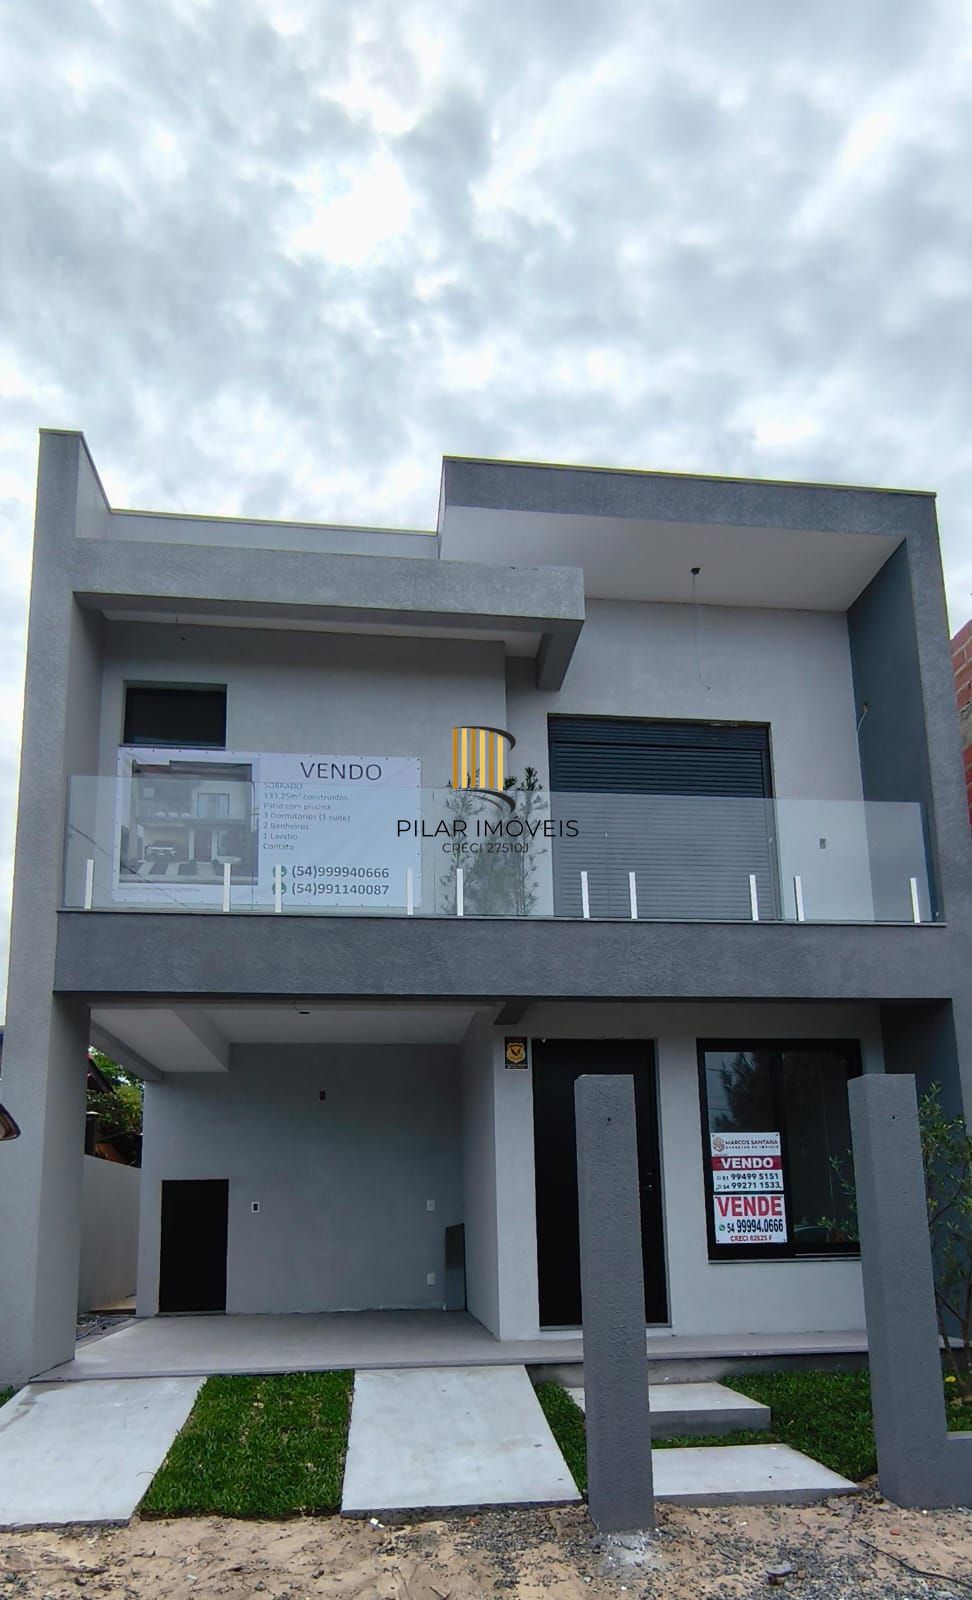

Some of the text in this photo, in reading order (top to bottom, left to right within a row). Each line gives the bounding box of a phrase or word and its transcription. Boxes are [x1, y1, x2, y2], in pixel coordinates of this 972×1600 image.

[300, 761, 382, 780] VENDO
[319, 813, 326, 822] (1
[270, 822, 309, 831] Banheiros
[270, 832, 298, 840] Lavabo
[262, 843, 295, 851] Contato
[292, 865, 390, 879] (54)999940666
[292, 882, 390, 897] (54)991140087
[720, 1157, 774, 1169] VENDO
[759, 1172, 779, 1180] 5151
[759, 1181, 780, 1189] 1533
[716, 1196, 783, 1216] VENDE
[727, 1218, 784, 1233] 54 99994.0666
